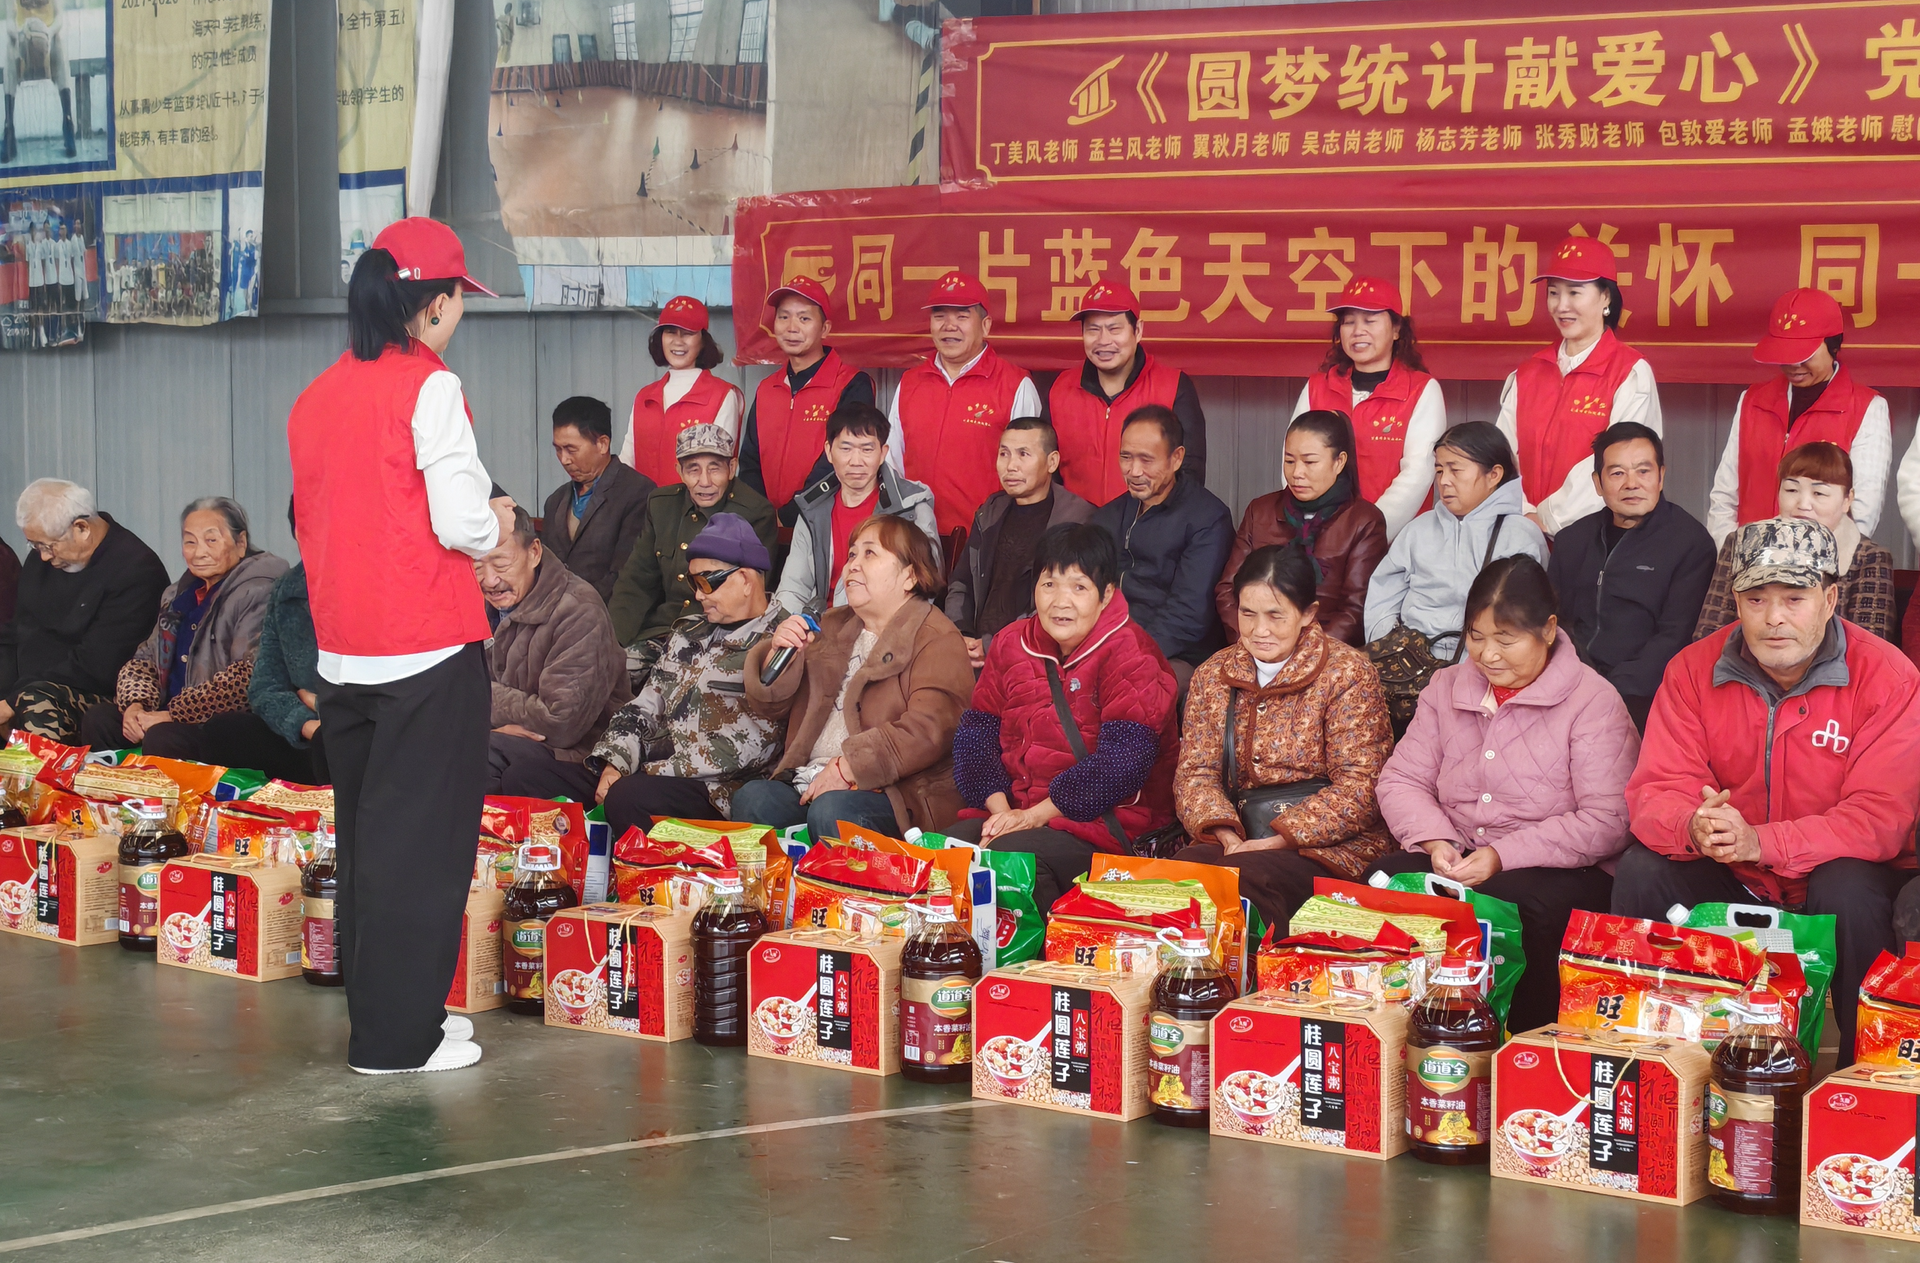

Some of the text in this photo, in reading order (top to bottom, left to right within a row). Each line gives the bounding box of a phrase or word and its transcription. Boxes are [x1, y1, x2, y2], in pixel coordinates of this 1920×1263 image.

[1136, 23, 1818, 124] 《圆梦统计献爱心》
[991, 113, 1920, 165] 丁美风老师 孟兰风老师 翼秋月老师 吴志岗老师 杨志芳老师 张秀财老师 包敦爱老师 孟娥老师 慰
[235, 837, 250, 856] 旺
[213, 876, 225, 951] 桂圆莲子
[639, 887, 656, 906] 旺
[812, 907, 828, 928] 旺
[1075, 946, 1098, 967] 旺
[819, 953, 834, 1041] 桂圆莲子
[837, 973, 848, 1015] 八宝粥
[1596, 994, 1625, 1020] 旺
[1054, 990, 1071, 1083] 桂圆莲子
[1074, 1011, 1088, 1056] 八宝粥
[1304, 1023, 1323, 1120] 桂圆莲子
[1327, 1046, 1341, 1091] 八宝粥
[1423, 1060, 1467, 1077] 道道全
[1593, 1060, 1615, 1162] 桂圆莲子
[1617, 1084, 1634, 1132] 八宝粥
